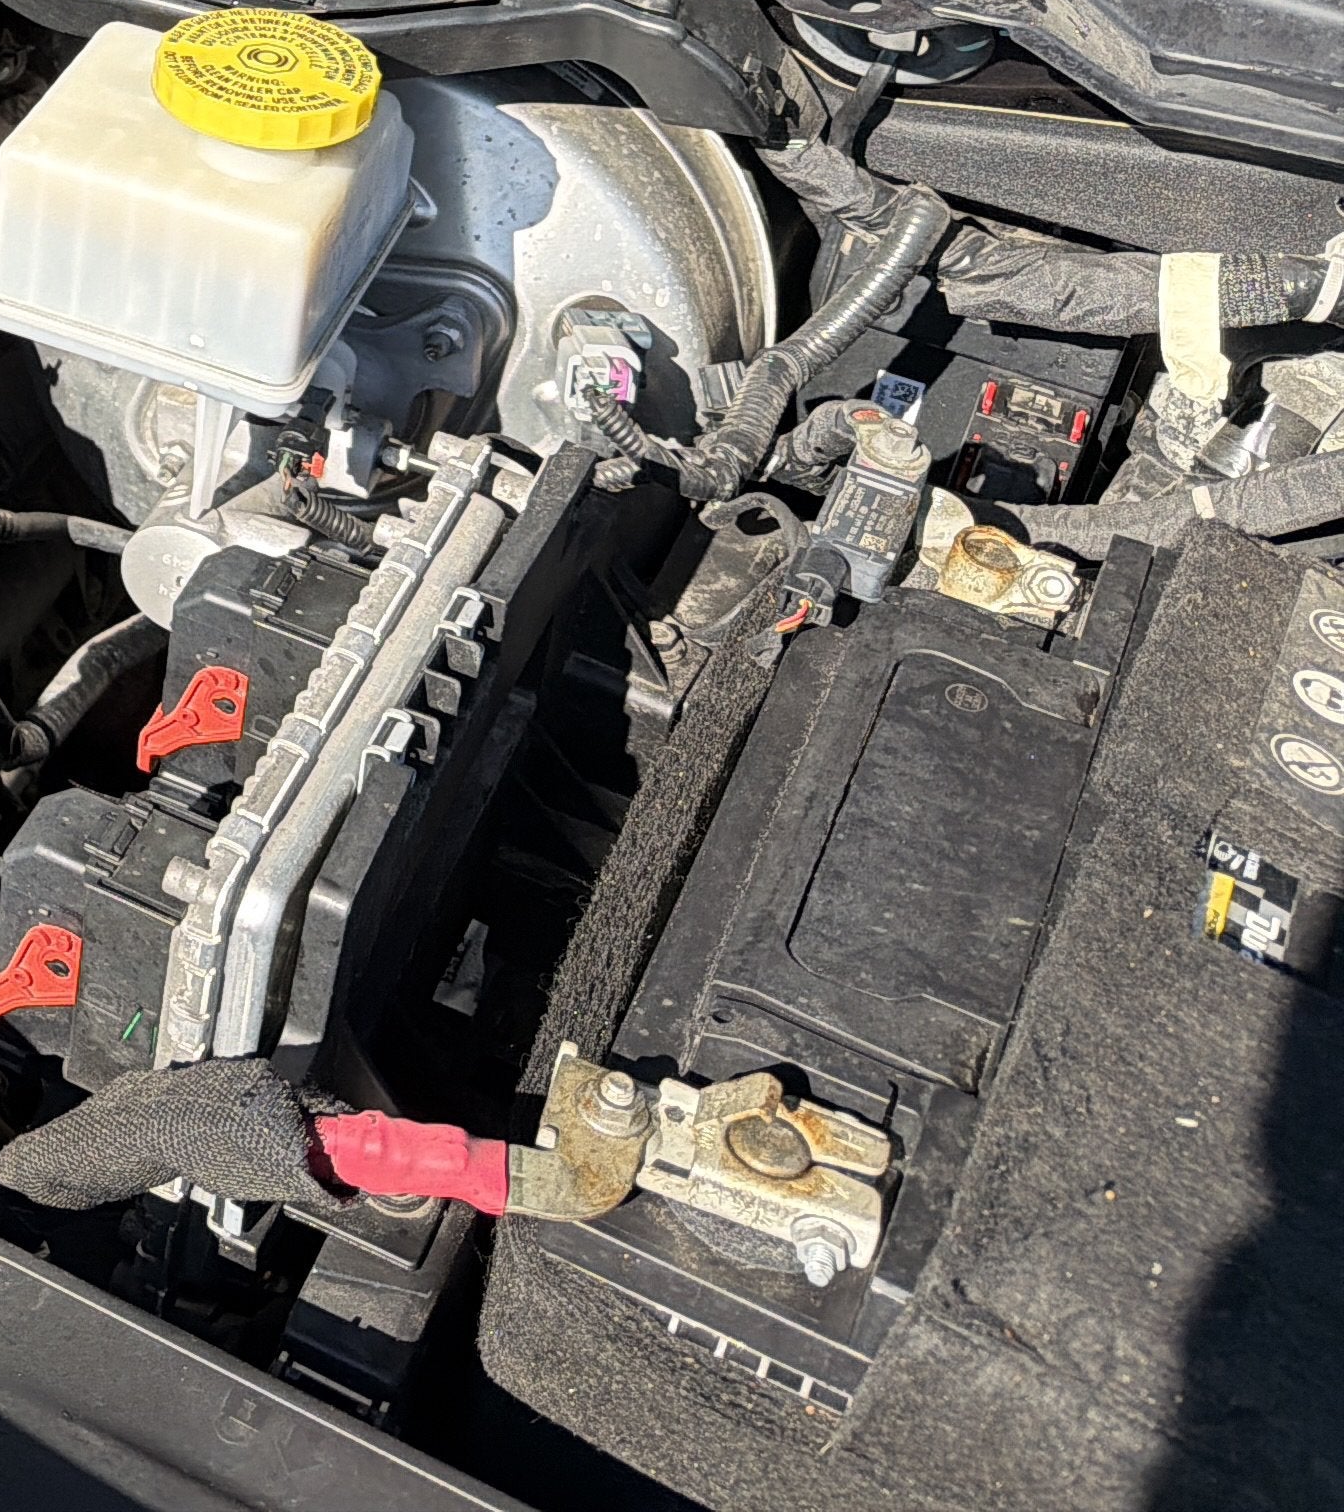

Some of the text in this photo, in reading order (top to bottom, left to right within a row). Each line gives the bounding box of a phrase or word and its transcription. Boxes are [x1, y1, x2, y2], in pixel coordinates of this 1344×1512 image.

[180, 55, 206, 79] BEFORE
[271, 96, 297, 104] USE
[190, 83, 225, 100] FROM
[200, 64, 304, 94] CLEAN FILLER CAP
